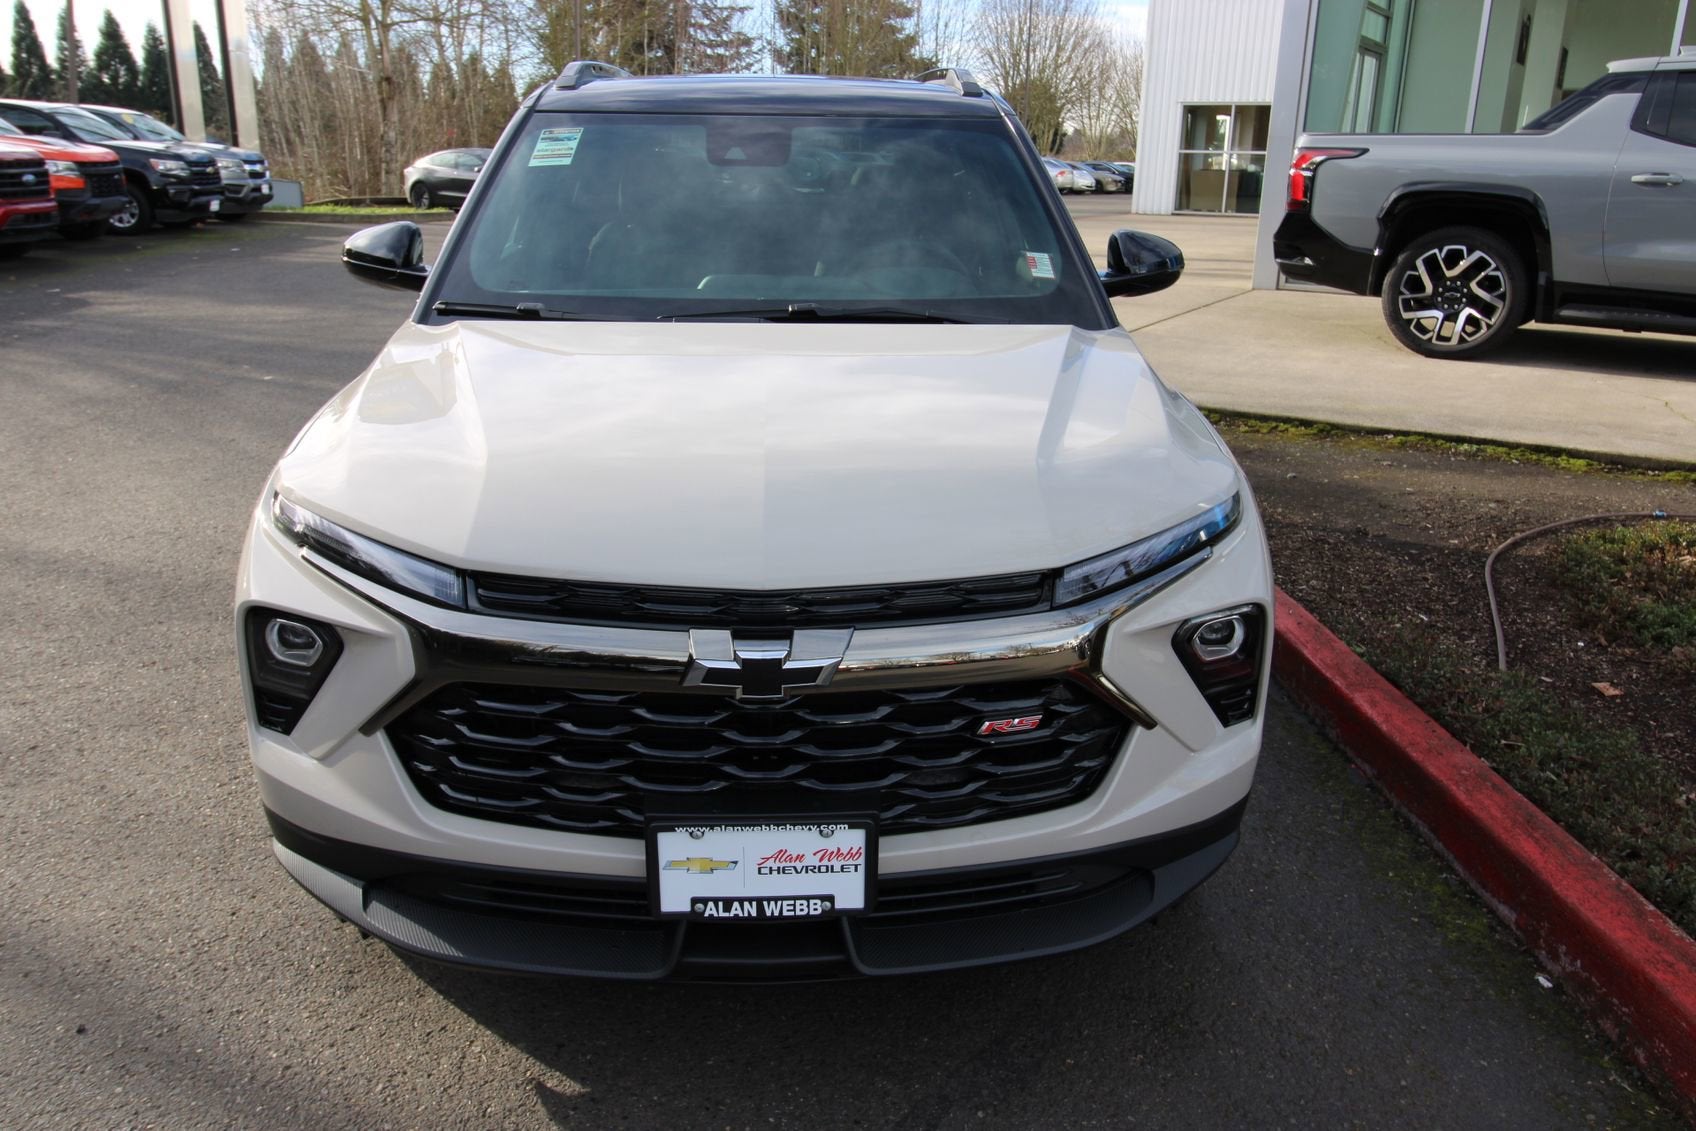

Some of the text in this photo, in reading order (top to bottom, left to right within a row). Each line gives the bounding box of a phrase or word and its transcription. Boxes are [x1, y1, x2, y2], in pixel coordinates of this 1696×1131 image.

[977, 715, 1042, 735] RS
[675, 823, 849, 833] www.alanwebbchevy.com
[757, 846, 863, 866] Alan Webb
[757, 864, 861, 875] CHEVROLET
[704, 899, 822, 917] ALAN WEBB
